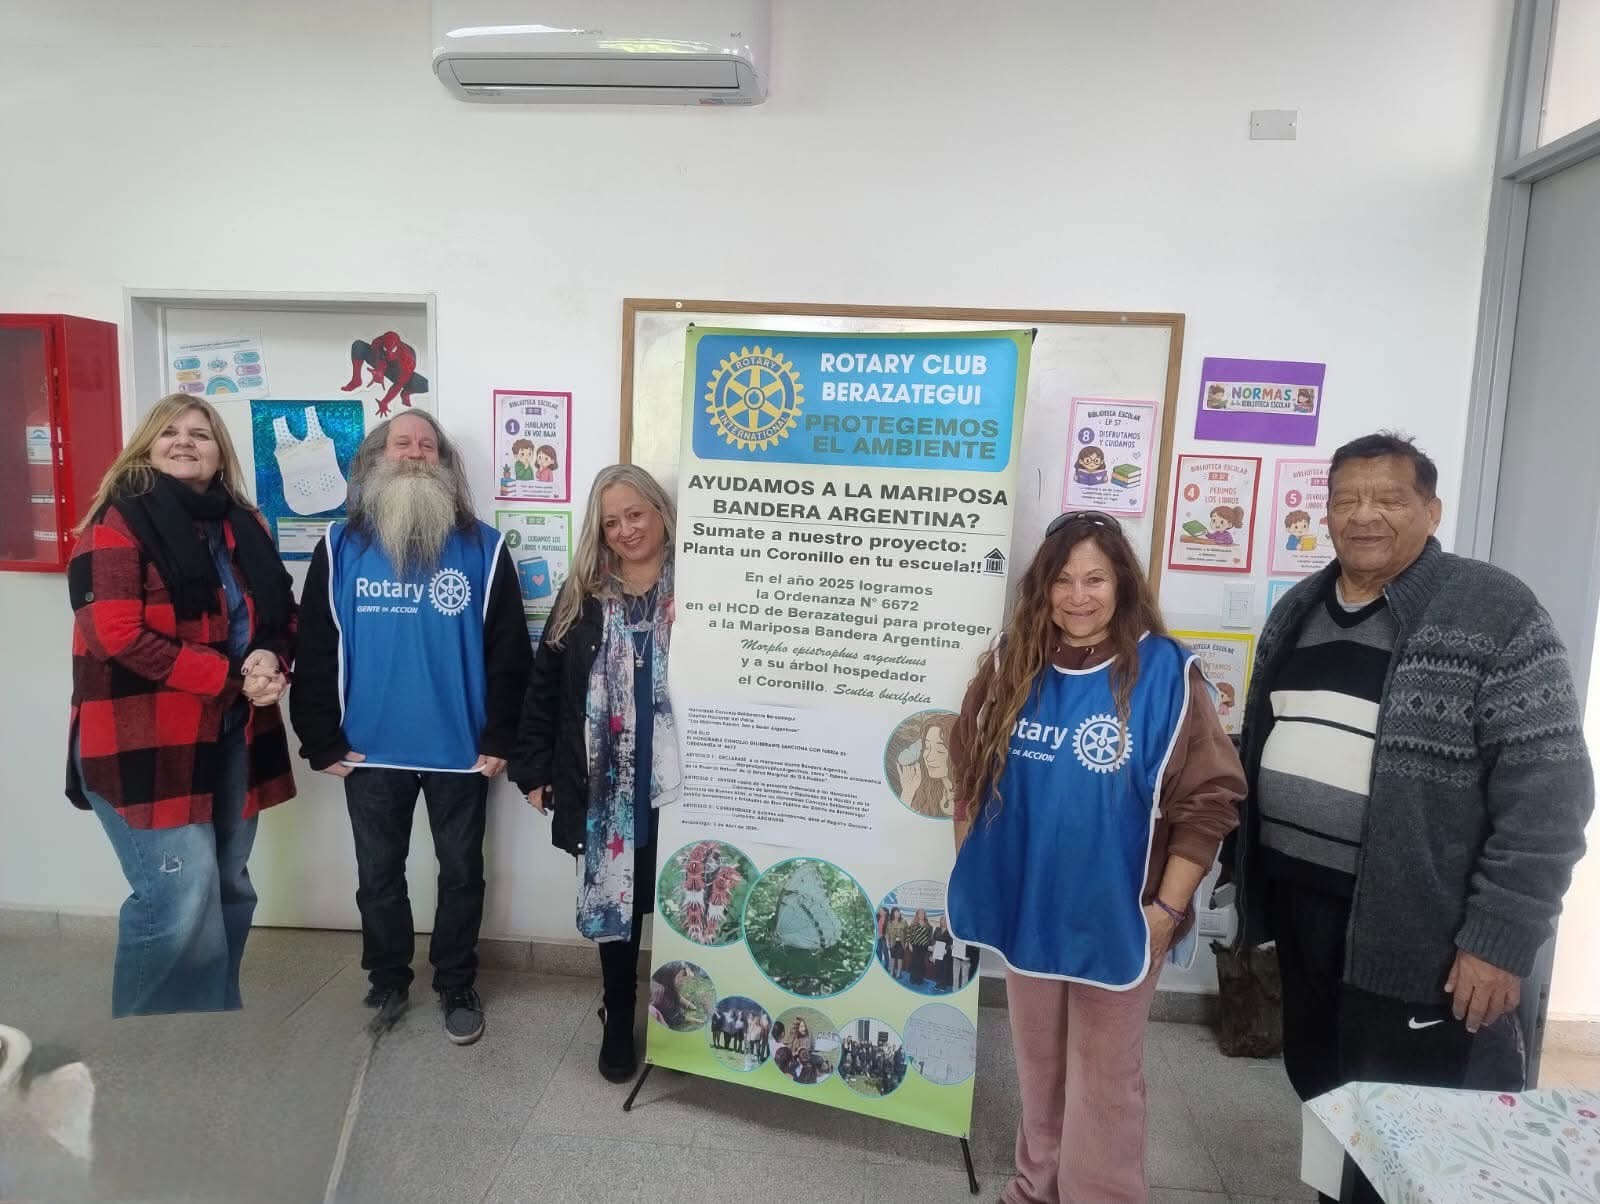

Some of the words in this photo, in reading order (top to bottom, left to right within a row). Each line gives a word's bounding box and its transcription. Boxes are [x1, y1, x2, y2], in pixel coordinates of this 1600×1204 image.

[736, 357, 777, 369] ROTARY
[820, 352, 915, 375] ROTARY
[923, 354, 988, 375] CLUB
[821, 382, 981, 405] BERAZATEGUI
[1232, 386, 1292, 401] NORMAS
[720, 414, 788, 440] INTERNATIONAL
[805, 414, 999, 438] PROTEGEMOS
[1083, 430, 1090, 441] 8
[1099, 430, 1140, 440] DISFRUTAMOS
[813, 435, 845, 454] EL
[853, 437, 996, 460] AMBIENTE
[688, 474, 815, 496] AYUDAMOS
[821, 481, 837, 497] A
[845, 483, 873, 499] LA
[881, 485, 1008, 505] MARIPOSA
[1188, 488, 1195, 498] 4
[1290, 493, 1297, 505] 5
[712, 499, 821, 520] BANDERA
[828, 504, 980, 529] ARGENTINA?
[510, 533, 517, 545] 2
[693, 522, 765, 540] Sumate
[771, 530, 782, 541] a
[789, 530, 863, 548] nuestro
[869, 536, 967, 556] proyecto:
[683, 542, 735, 558] Planta
[740, 547, 761, 558] un
[767, 547, 844, 566] Coronillo
[850, 555, 871, 567] en
[875, 555, 893, 568] tu
[899, 558, 982, 574] escuela!!
[356, 578, 424, 602] Rotary
[745, 572, 764, 583] En
[768, 573, 782, 584] el
[786, 575, 814, 586] año
[819, 577, 854, 590] 2025
[859, 579, 933, 597] logramos
[756, 589, 769, 600] la
[774, 590, 855, 606] Ordenanza
[882, 598, 919, 611] 6672
[685, 602, 703, 611] en
[708, 601, 722, 612] el
[726, 602, 760, 615] HCD
[765, 605, 783, 617] de
[788, 607, 878, 626] Berazategui
[882, 617, 918, 630] para
[923, 620, 992, 636] proteger
[709, 620, 717, 628] a
[722, 618, 735, 630] la
[740, 620, 810, 637] Mariposa
[815, 625, 878, 642] Bandera
[740, 639, 788, 654] Morpho
[792, 643, 859, 661] epistrophus
[863, 651, 927, 667] argentinus
[741, 658, 749, 668] y
[754, 658, 762, 667] a
[767, 660, 785, 670] su
[789, 658, 828, 674] árbol
[833, 664, 927, 683] hospedador
[738, 675, 751, 685] el
[833, 684, 875, 698] Scutia
[1010, 718, 1068, 750] tary
[1022, 750, 1055, 762] ACCION
